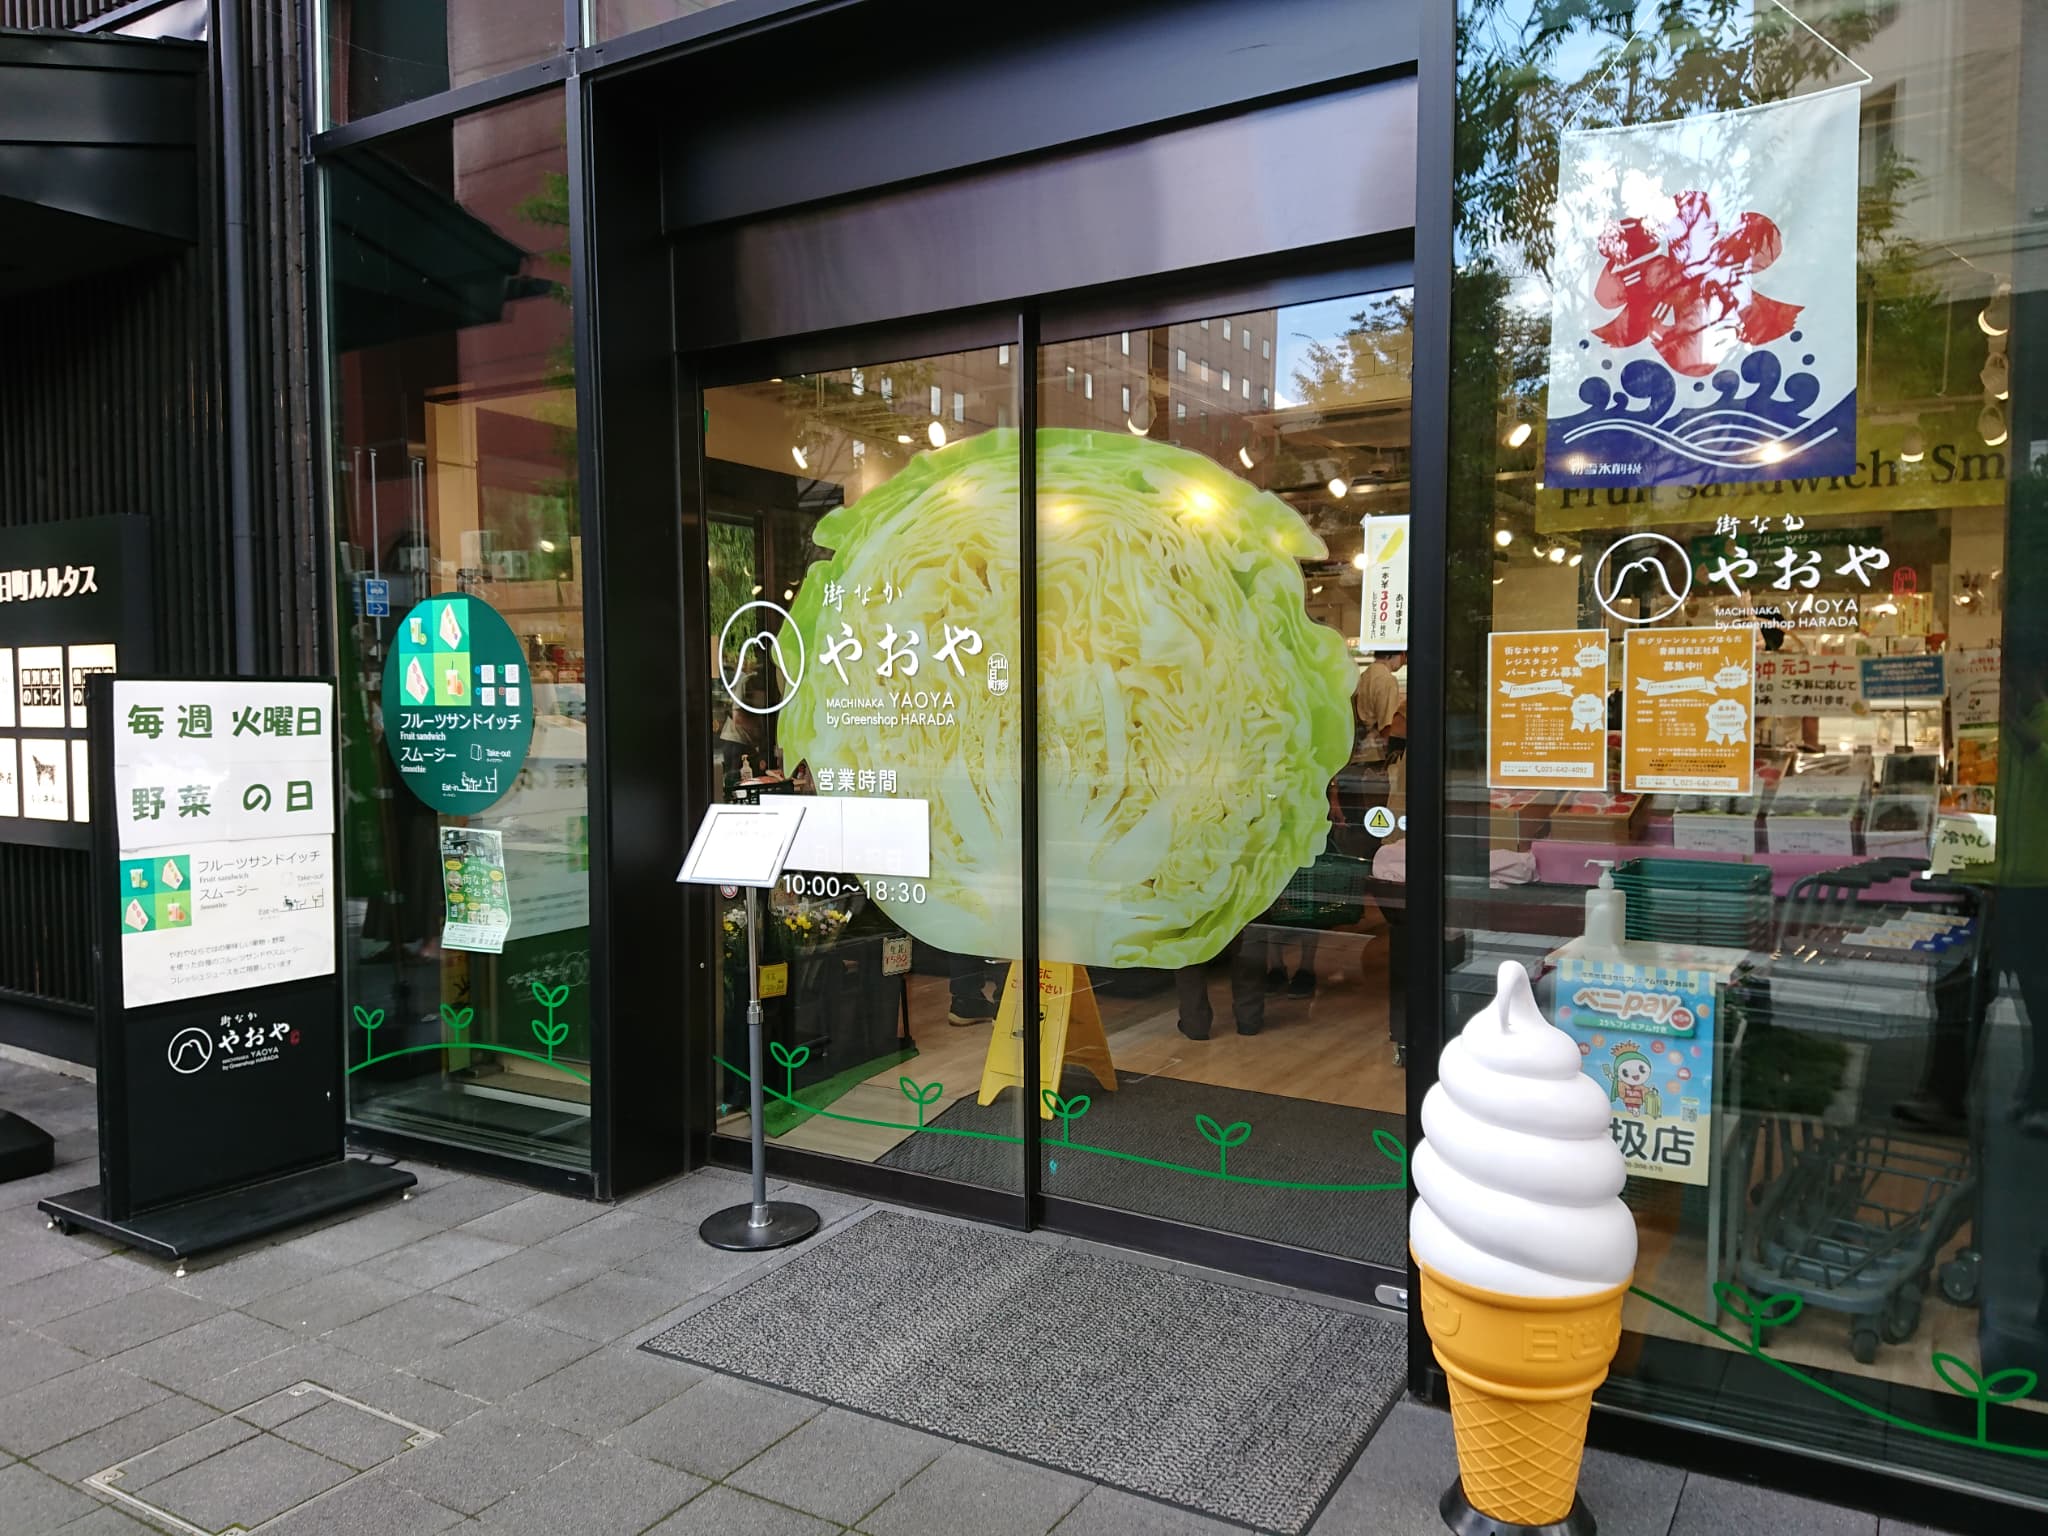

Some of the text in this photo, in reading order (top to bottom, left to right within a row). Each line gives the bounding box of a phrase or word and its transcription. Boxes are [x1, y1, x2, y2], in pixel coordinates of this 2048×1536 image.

[1714, 513, 1805, 540] 街なか
[1708, 544, 1891, 598] やおや
[822, 581, 903, 613] 街なか
[1715, 598, 1859, 617] MACHINAKA YAOYA
[1715, 615, 1859, 631] by Greenshop HARADA
[818, 621, 984, 686] やおや
[22, 687, 62, 706] のトライ
[826, 691, 956, 710] MACHINAKA YAOYA
[127, 704, 322, 739] 毎週 火曜日
[400, 713, 522, 731] フルーツサンドイッチ
[826, 713, 956, 728] by Greenshop HARADA
[400, 731, 447, 741] Fruit sandwich
[400, 746, 457, 763] スムージー
[485, 748, 511, 758] Take-out
[400, 764, 427, 774] Smoothie
[441, 783, 459, 792] Eat-in
[817, 767, 898, 793] 営業時間
[132, 784, 212, 821] 野菜
[198, 850, 321, 874] フルーツサンドイッチ
[199, 884, 260, 901] スムージー
[1574, 989, 1682, 1022] ベニpay
[219, 1011, 257, 1028] 街なか
[217, 1022, 290, 1054] やおや
[250, 1045, 280, 1058] YAOYA
[1609, 1116, 1696, 1167] 扱店
